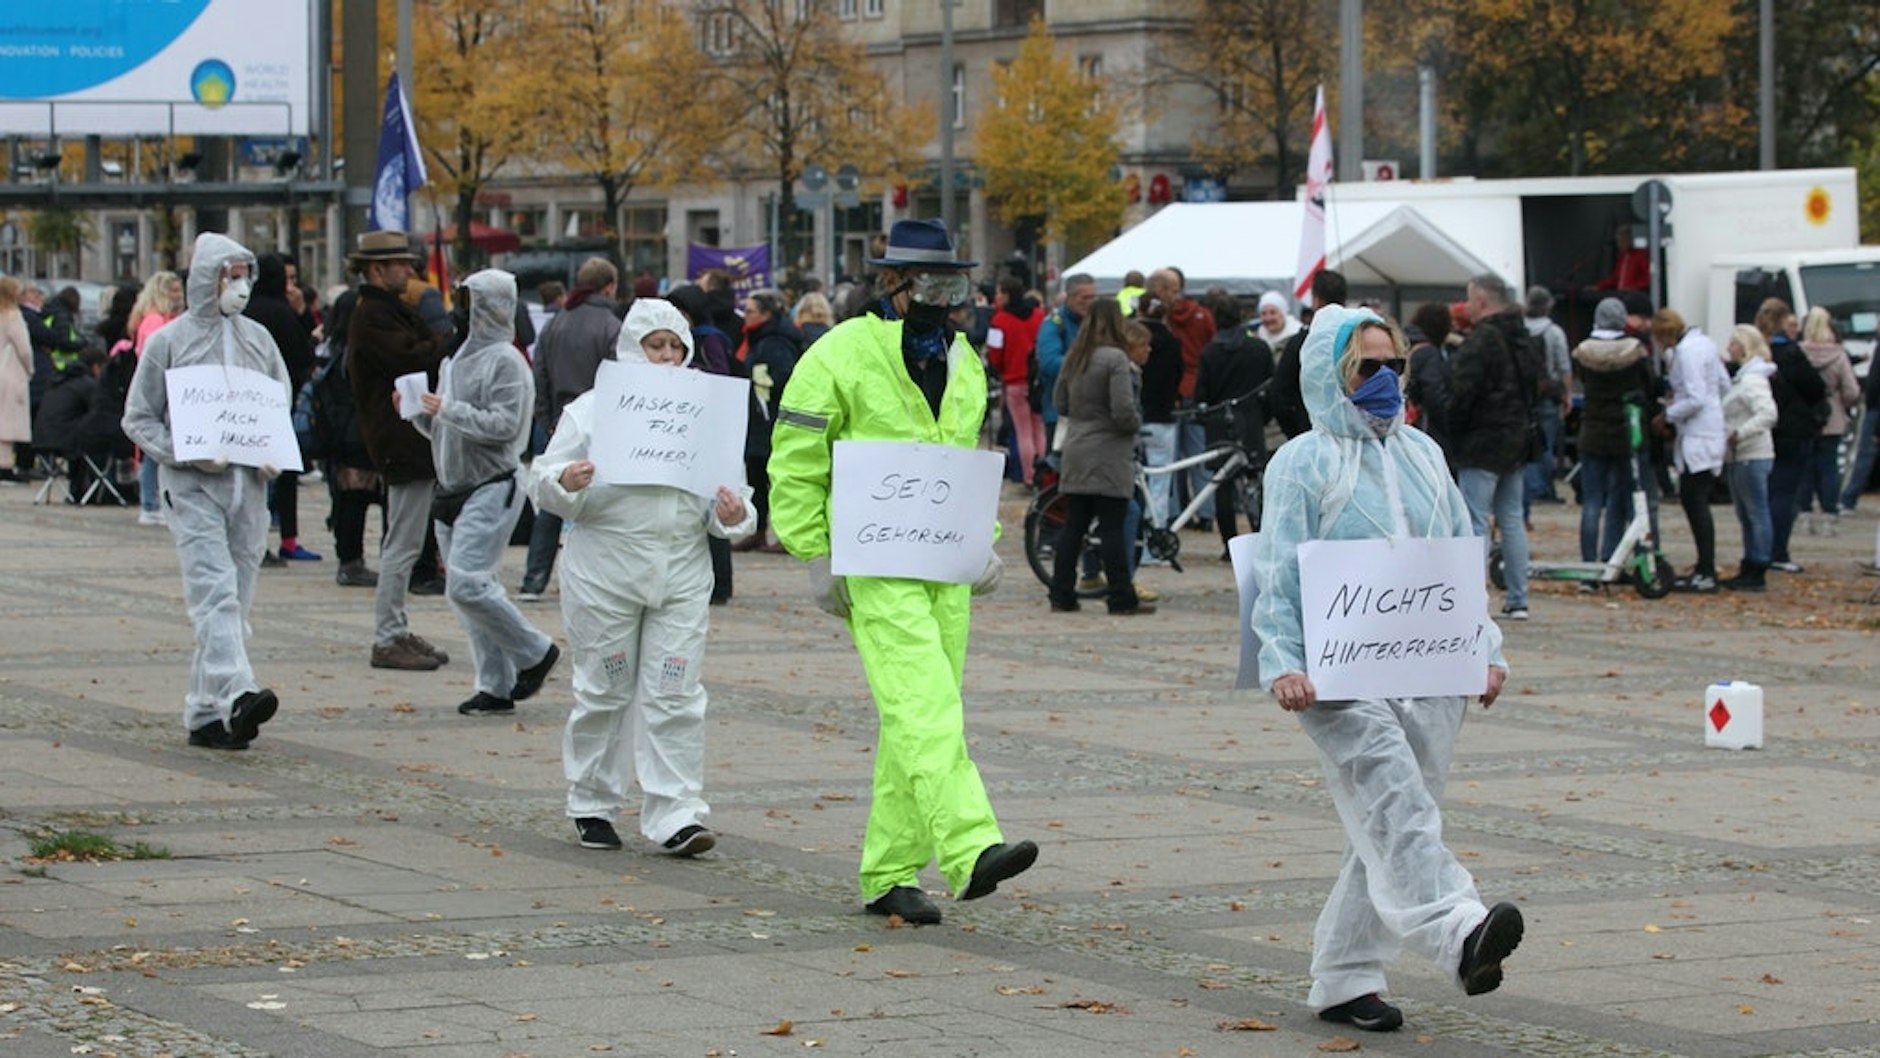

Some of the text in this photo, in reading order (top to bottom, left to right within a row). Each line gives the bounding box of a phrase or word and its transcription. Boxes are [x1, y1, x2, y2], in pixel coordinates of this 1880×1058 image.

[69, 45, 124, 58] POLICIES
[215, 410, 259, 425] AUCH
[615, 394, 704, 419] MASKEN
[219, 431, 272, 448] HAUSE
[629, 447, 699, 471] IMMER!
[871, 473, 950, 504] SEID
[856, 523, 965, 548] GEHORSAM
[1326, 582, 1456, 621] NICHTS
[1318, 623, 1484, 667] HINTERFRAGEN!
